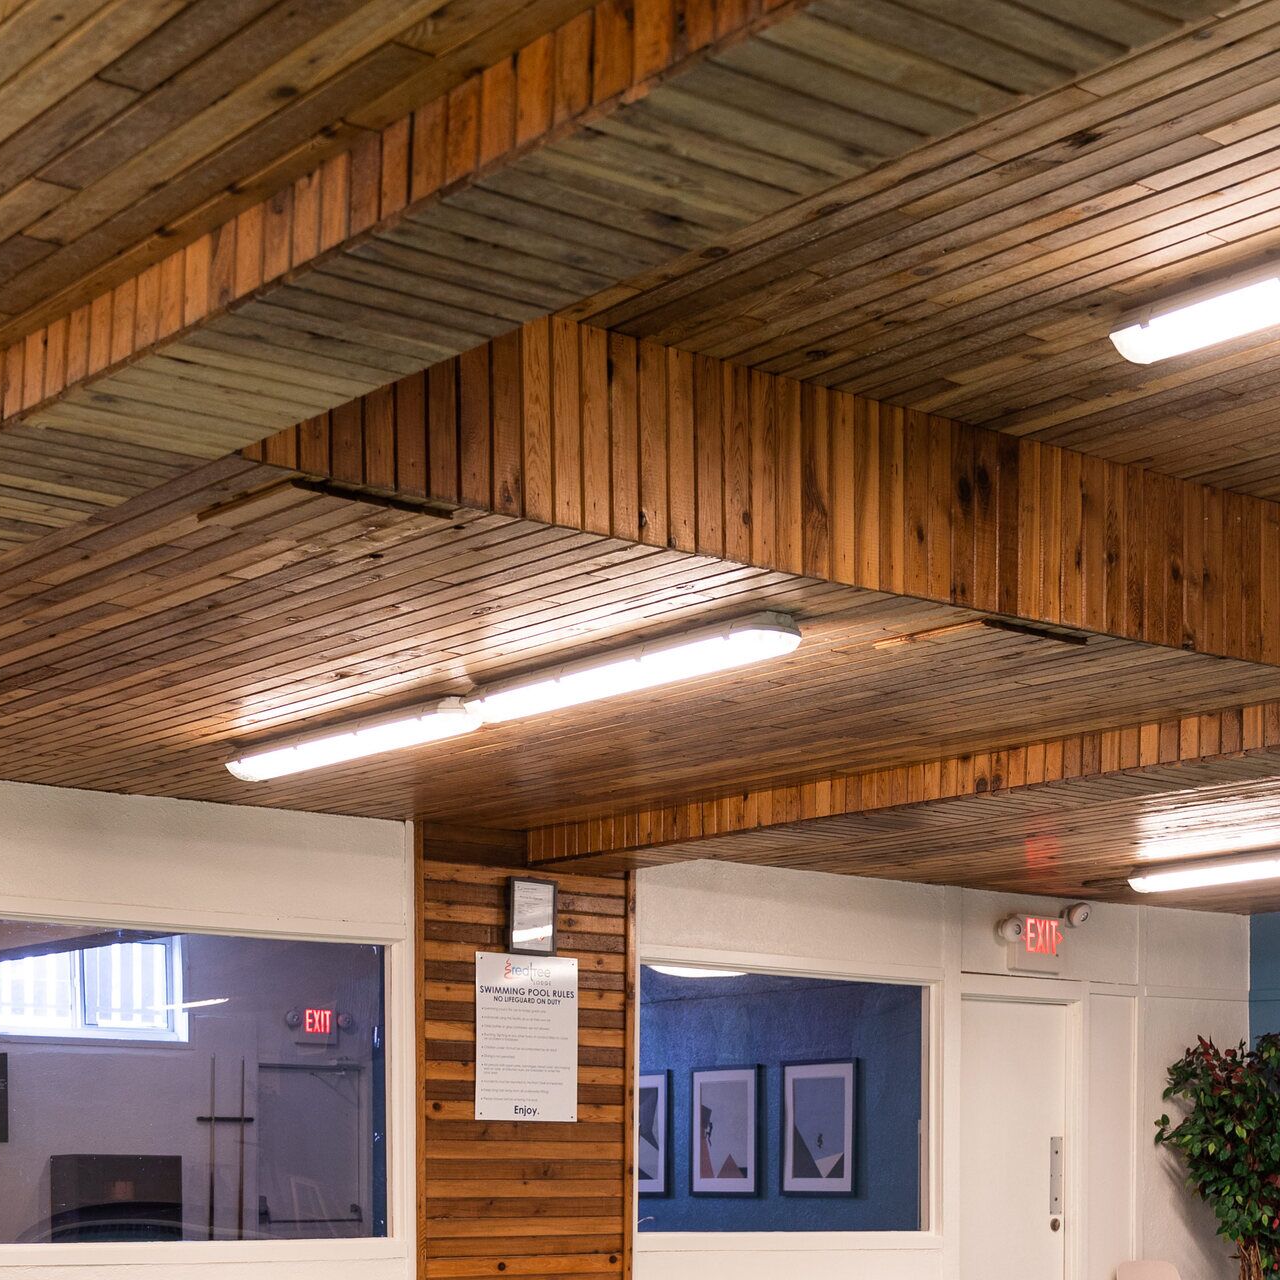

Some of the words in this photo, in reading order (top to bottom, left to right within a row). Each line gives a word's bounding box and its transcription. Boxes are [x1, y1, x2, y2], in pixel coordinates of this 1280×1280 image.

[1026, 917, 1059, 955] EXIT
[479, 985, 526, 996] SWIMMING
[528, 988, 551, 998] POOL
[552, 990, 575, 999] RULES
[493, 995, 503, 1003] NO
[504, 996, 536, 1004] LIFEGUARD
[304, 1008, 332, 1034] EXIT
[513, 1105, 540, 1117] Enjoy.
